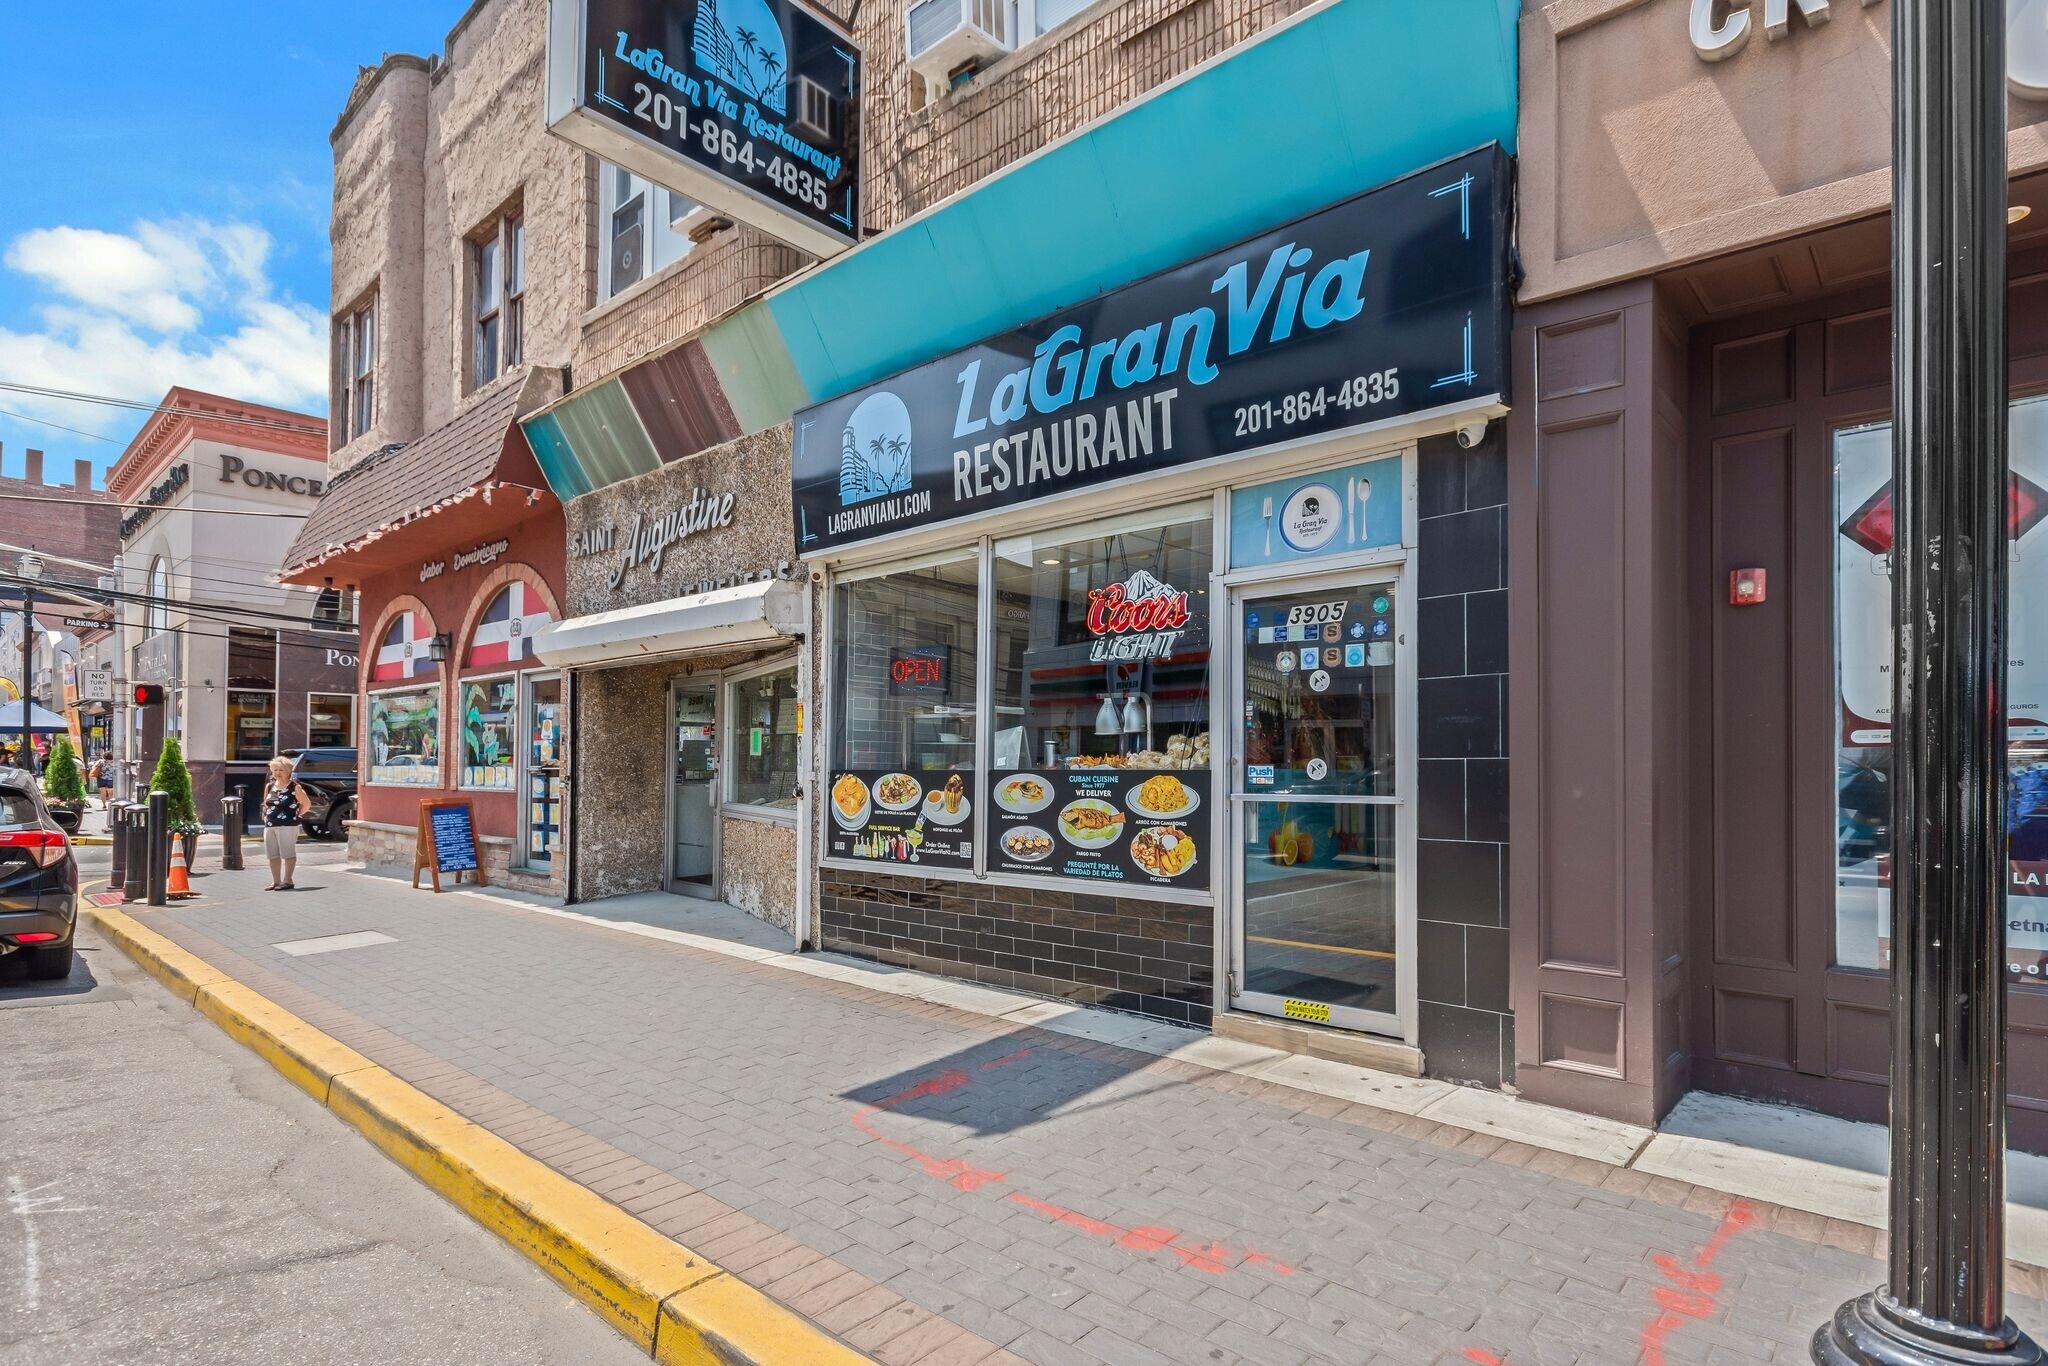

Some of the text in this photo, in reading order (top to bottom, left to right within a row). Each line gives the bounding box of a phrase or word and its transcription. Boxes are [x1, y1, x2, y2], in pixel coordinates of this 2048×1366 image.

[634, 81, 828, 212] 201-864-4835
[742, 101, 842, 182] Restaurant
[1210, 241, 1371, 356] Via
[1234, 367, 1400, 437] 201-864-4835
[953, 387, 1179, 502] RESTAURANT
[219, 454, 324, 497] PONCE
[828, 489, 932, 536] LAGRANVIANJ.COM
[1302, 518, 1317, 529] Gran
[1318, 517, 1328, 526] Via
[572, 487, 737, 590] SAINT Augustine
[420, 539, 510, 584] Sabor Dominicano
[66, 619, 99, 628] PARKING
[1087, 582, 1192, 635] Coors
[1289, 602, 1345, 625] 3905
[1089, 631, 1177, 662] LIGHT
[893, 658, 941, 682] OPEN
[1069, 775, 1119, 783] CUBAN CUISINE
[1086, 789, 1112, 797] DELIVER
[1249, 766, 1273, 777] Push
[1063, 867, 1091, 876] VARIEDAD
[1100, 870, 1124, 879] PLATOS
